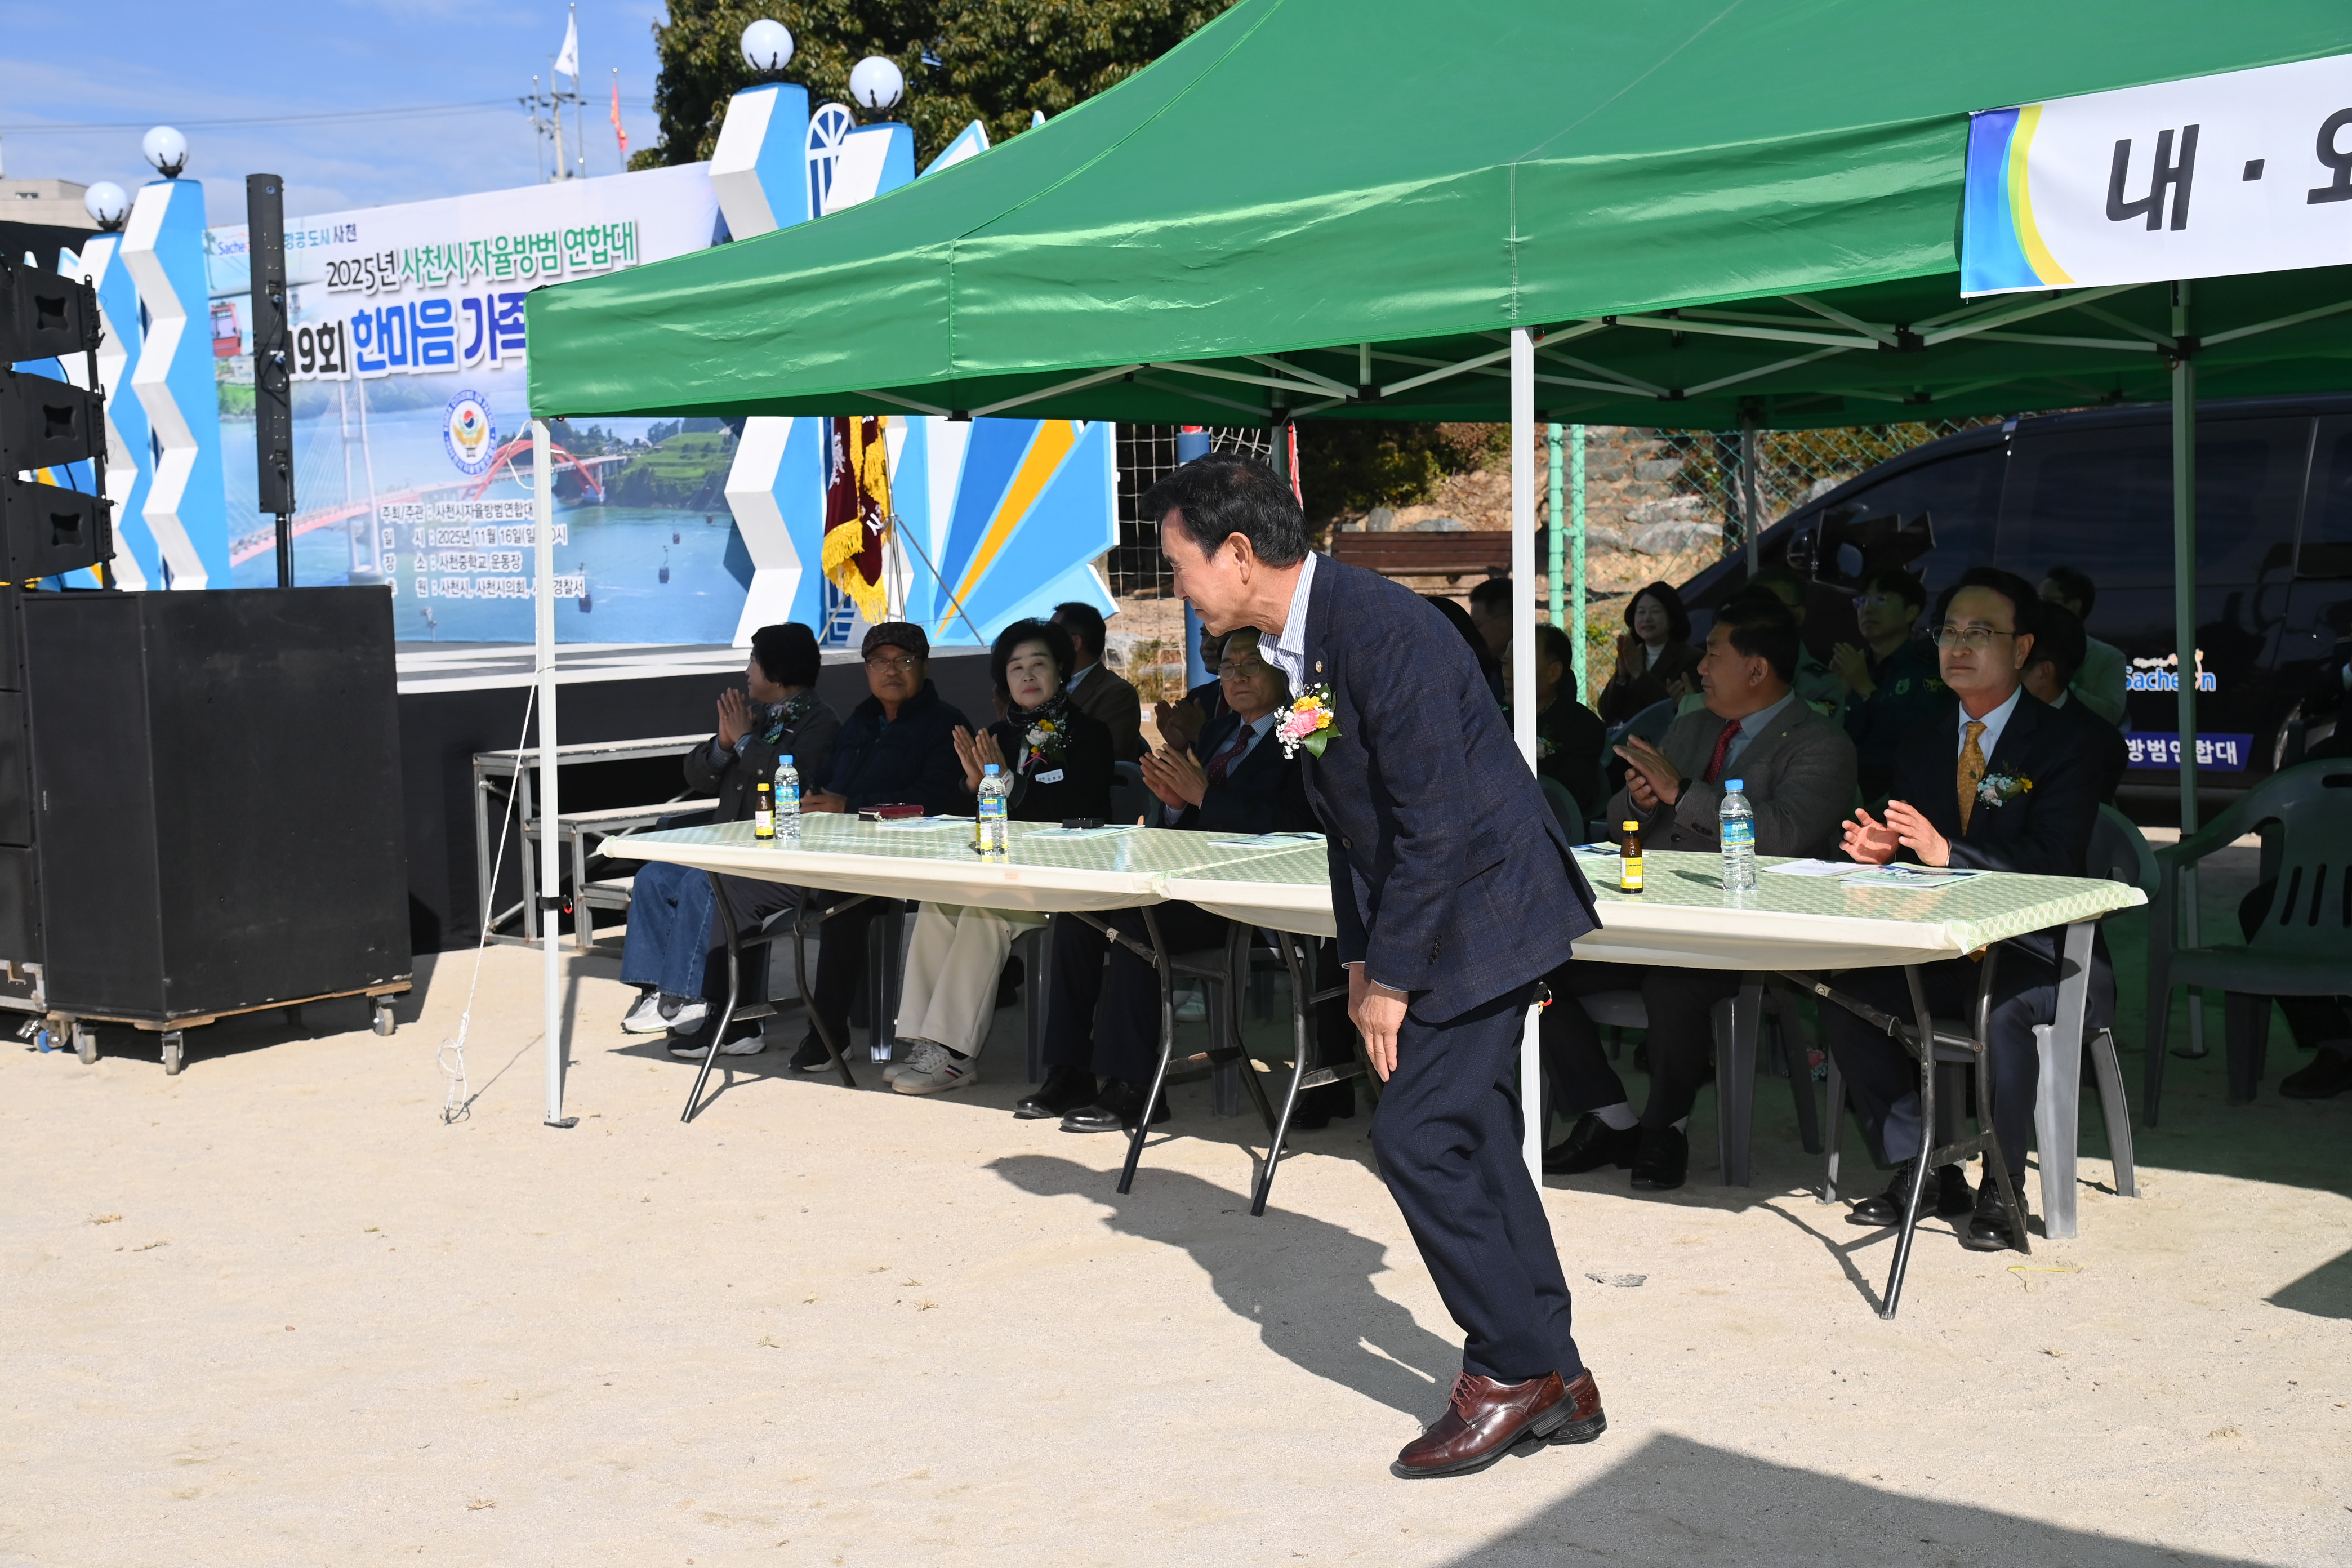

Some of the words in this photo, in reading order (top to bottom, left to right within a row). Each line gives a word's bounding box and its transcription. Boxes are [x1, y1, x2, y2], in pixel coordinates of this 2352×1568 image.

[2106, 123, 2200, 231] 내
[326, 250, 395, 289] 2025년
[564, 221, 635, 266] 연합대
[351, 298, 455, 372] 한마음
[382, 505, 423, 522] 주최/주관
[438, 529, 470, 545] 2025년
[475, 528, 496, 544] 11월
[501, 527, 535, 544] 16일(일
[440, 554, 487, 570] 사천중학교
[492, 554, 520, 569] 운동장
